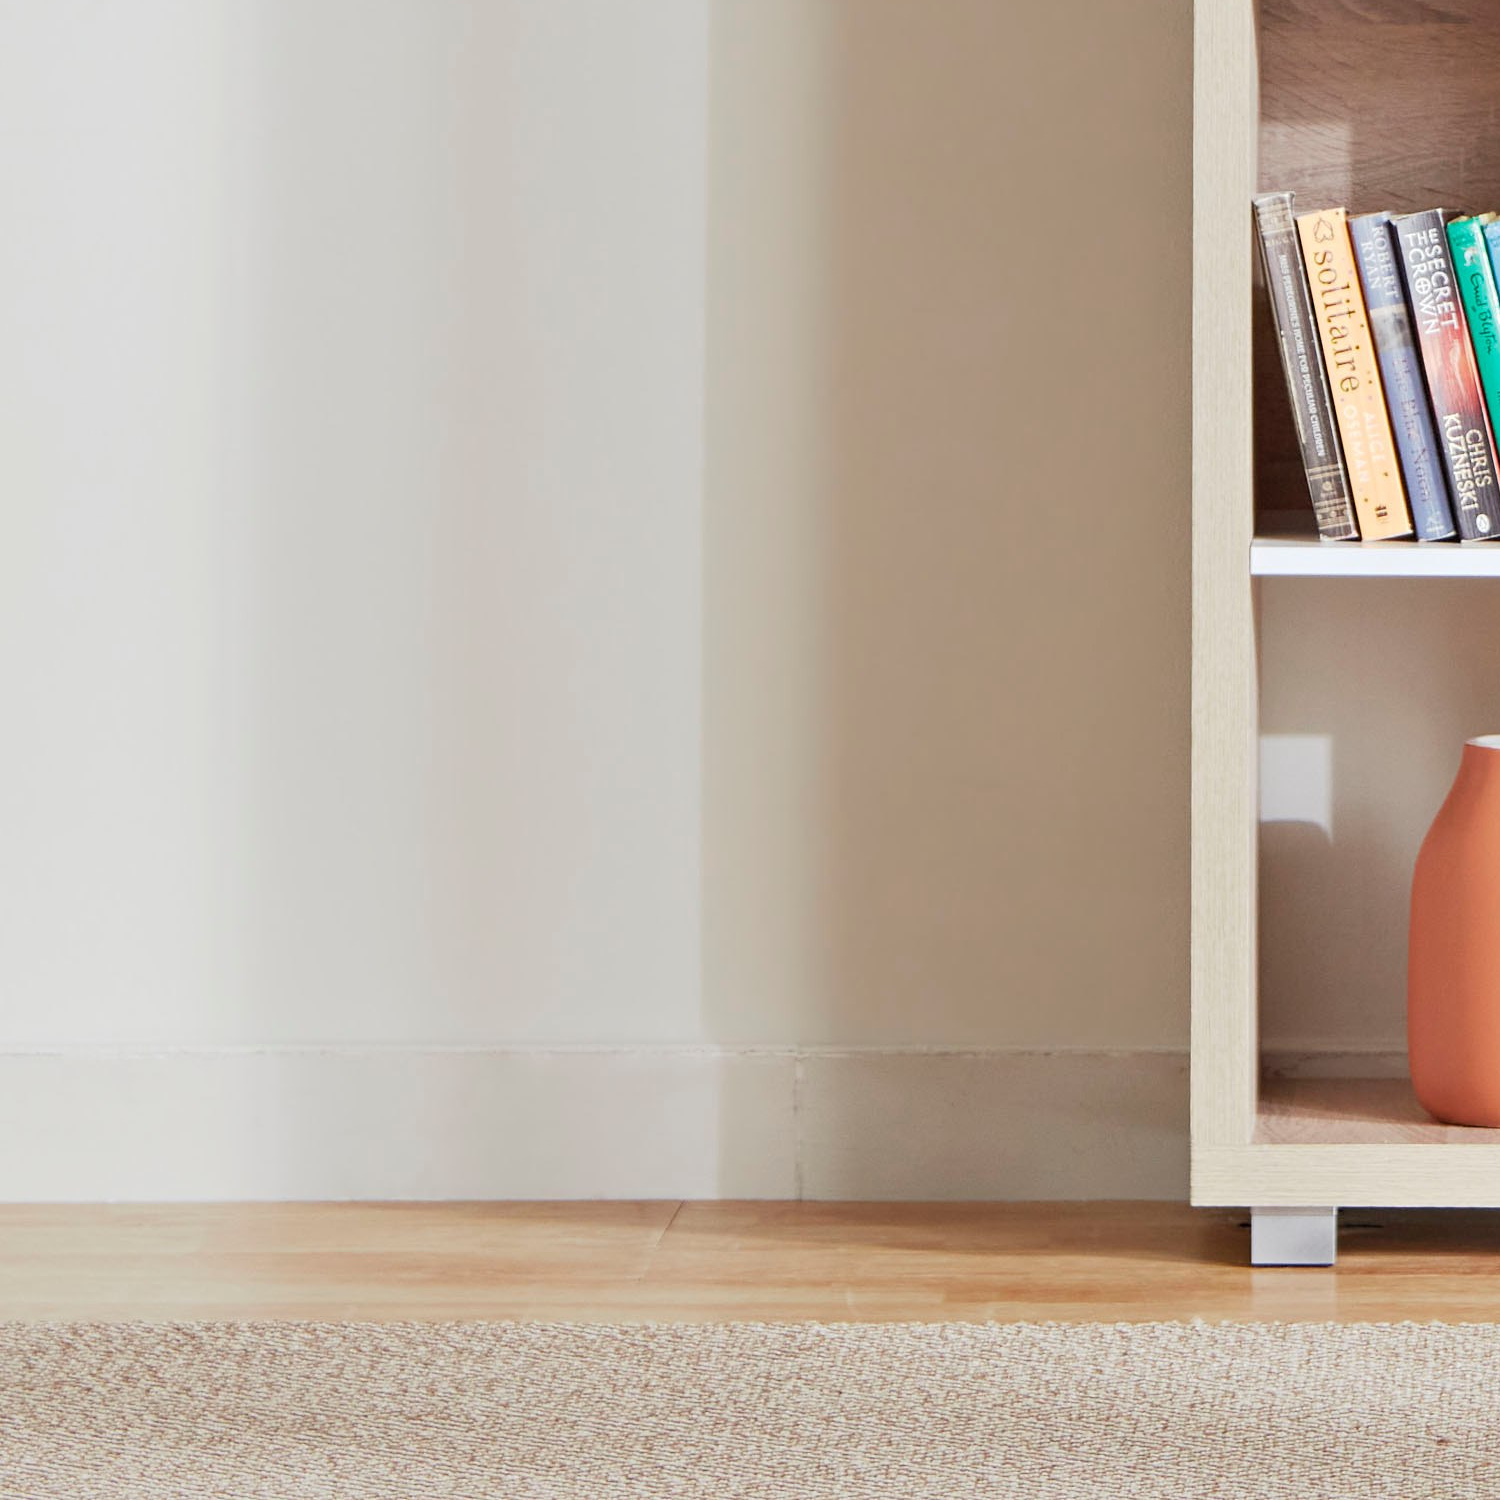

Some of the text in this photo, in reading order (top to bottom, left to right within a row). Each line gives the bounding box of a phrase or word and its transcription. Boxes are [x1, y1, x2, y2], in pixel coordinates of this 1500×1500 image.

[1277, 253, 1289, 274] MISS
[1360, 241, 1381, 289] RYAN
[1371, 226, 1397, 299] ROBERT
[1405, 227, 1439, 249] THE
[1408, 247, 1440, 334] CROWN
[1424, 245, 1457, 331] SECRET
[1468, 272, 1498, 356] Enid Blyton
[1292, 328, 1306, 354] HOME
[1312, 248, 1365, 392] solitaire
[1298, 354, 1309, 373] FOR
[1301, 373, 1317, 413] PECULIAR
[1309, 414, 1325, 456] CHILDREN
[1342, 404, 1370, 483] OSEMAN
[1362, 410, 1384, 462] ALICE
[1391, 358, 1435, 502] The Blue Noon
[1464, 428, 1491, 487] CHRIS
[1442, 413, 1477, 510] KUZNESKI
